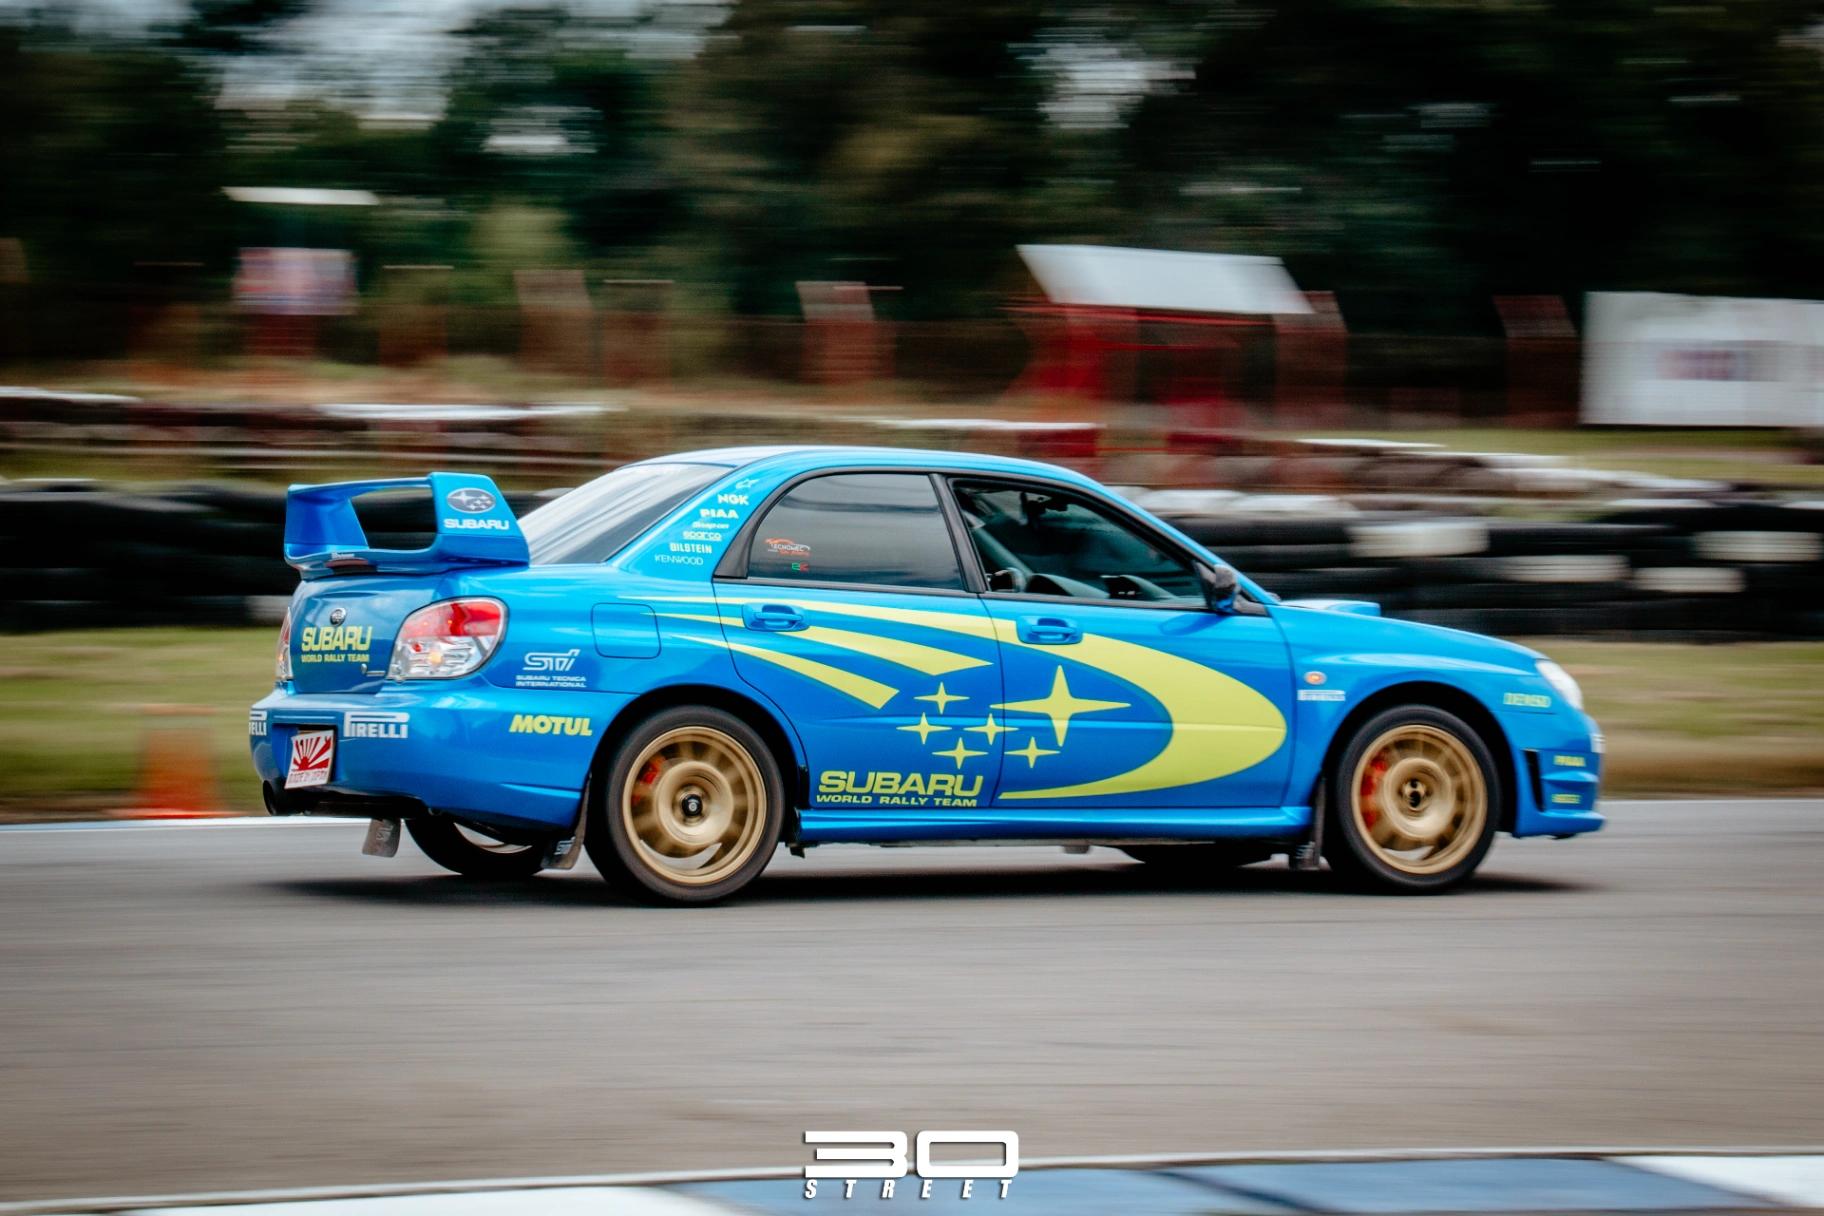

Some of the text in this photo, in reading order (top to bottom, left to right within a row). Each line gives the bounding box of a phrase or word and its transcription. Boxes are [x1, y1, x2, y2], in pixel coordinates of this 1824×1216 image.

[718, 494, 749, 505] NGK
[699, 508, 739, 519] PIAA
[443, 518, 509, 530] SUBARU
[655, 554, 703, 565] KENWOOD
[301, 626, 373, 651] SUBARU
[344, 712, 410, 738] PIRELLI
[509, 714, 593, 737] MOTUL
[818, 770, 984, 797] SUBARU
[816, 794, 977, 807] WORLD RALLY TEAM
